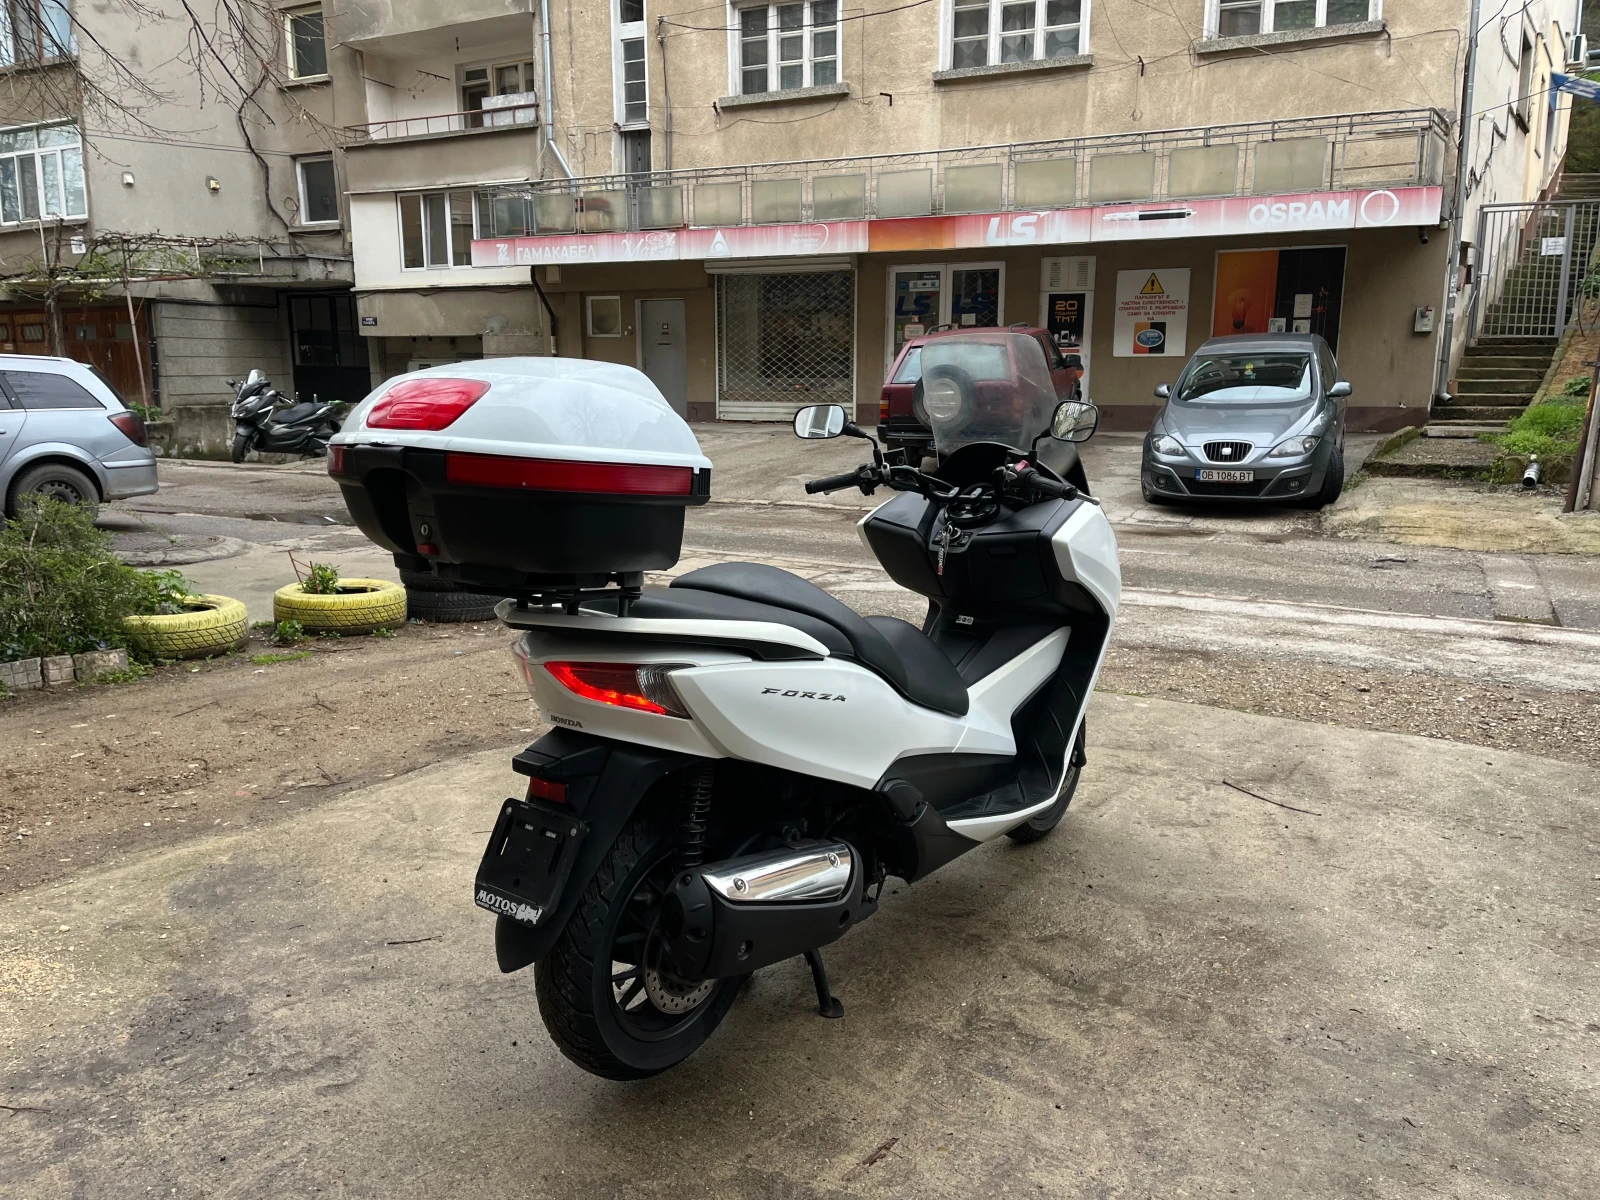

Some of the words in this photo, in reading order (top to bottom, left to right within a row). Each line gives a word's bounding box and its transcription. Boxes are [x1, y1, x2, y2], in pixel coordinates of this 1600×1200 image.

[1249, 198, 1349, 227] OSRAM
[985, 215, 1037, 246] LS
[516, 243, 596, 261] ГАМАКАБЕЛ
[896, 295, 932, 316] LS
[952, 293, 990, 314] LS
[1055, 300, 1078, 311] 20
[1201, 470, 1214, 480] OB
[1216, 471, 1238, 481] 1086
[1239, 472, 1253, 481] BT
[760, 686, 847, 702] FORZA
[550, 714, 584, 728] HONDA
